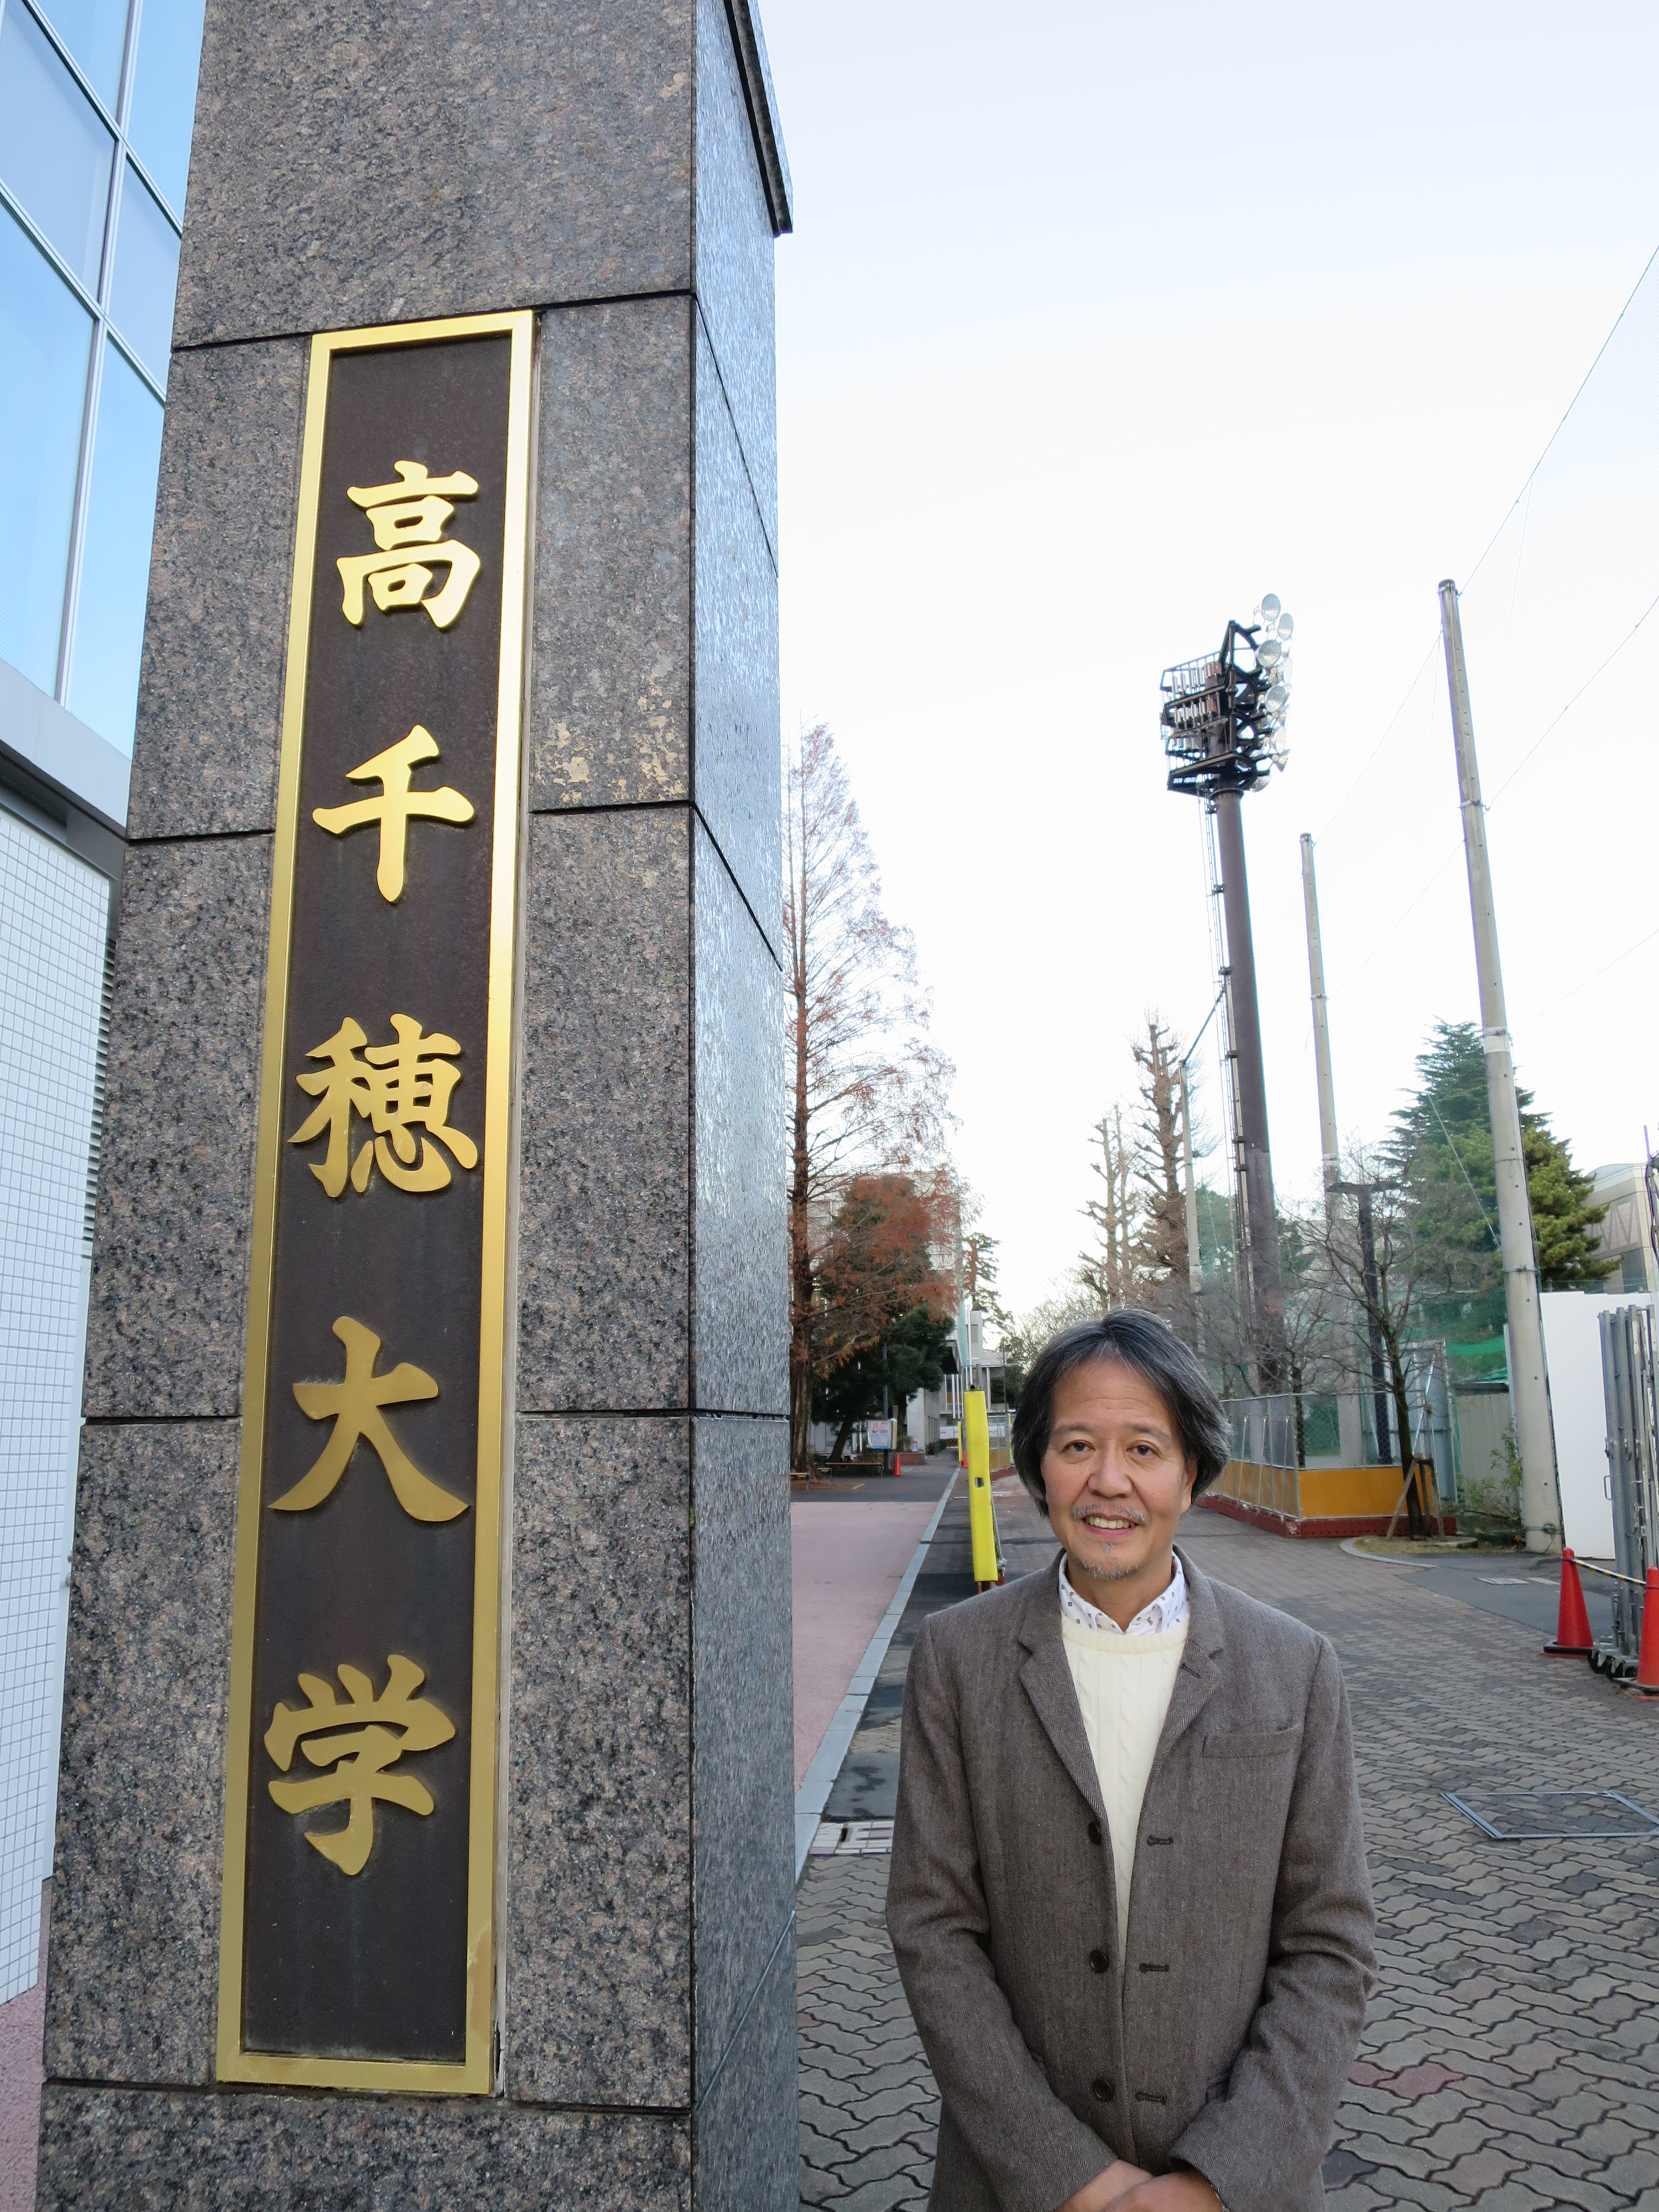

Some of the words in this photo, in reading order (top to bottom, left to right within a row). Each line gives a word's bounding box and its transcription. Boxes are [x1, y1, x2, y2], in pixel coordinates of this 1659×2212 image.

[264, 460, 481, 1875] 高千穂大学
